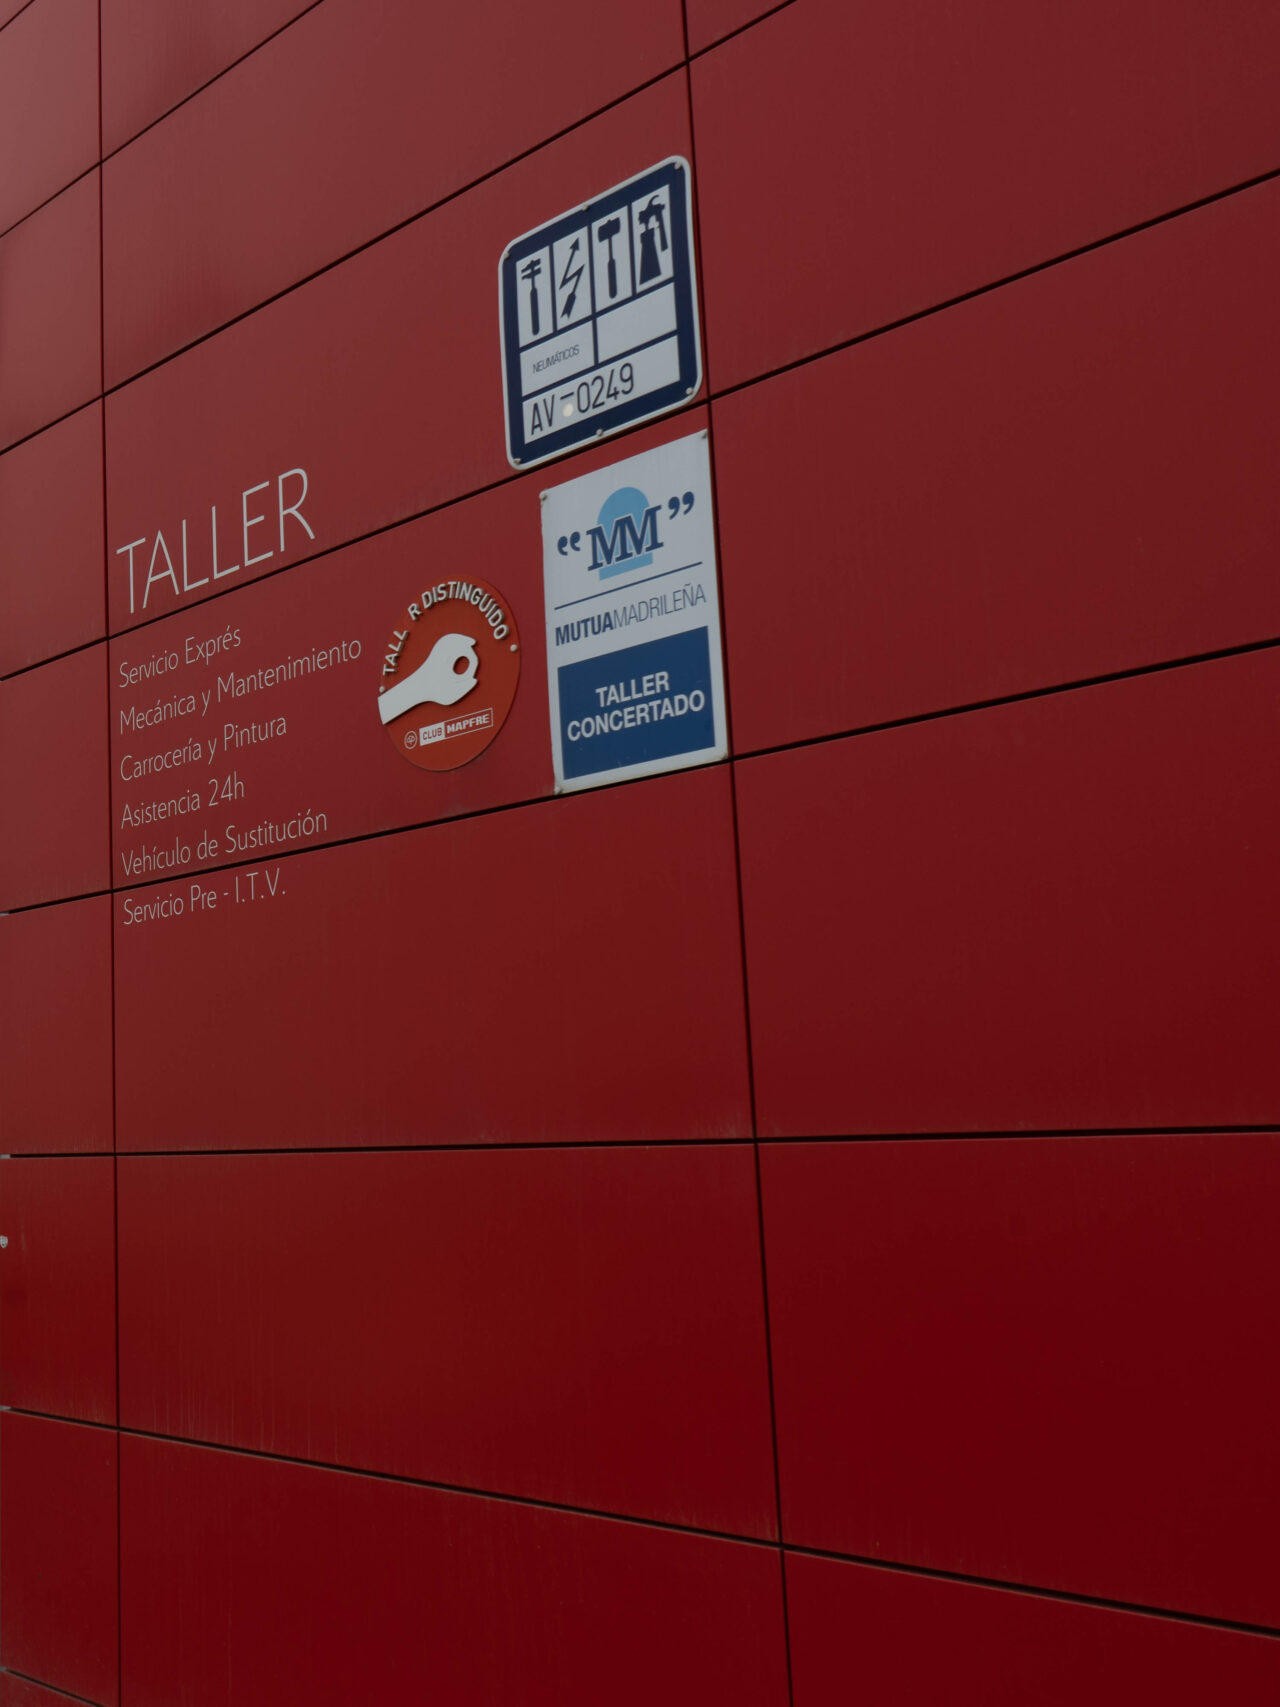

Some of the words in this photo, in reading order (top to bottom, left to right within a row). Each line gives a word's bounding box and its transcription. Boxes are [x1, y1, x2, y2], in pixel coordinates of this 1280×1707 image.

[532, 344, 580, 374] NEUMÁTICOS
[530, 362, 635, 436] AV-0249
[116, 467, 316, 614] TALLER
[421, 580, 510, 640] DISTINGUIDO
[119, 648, 179, 688] Servicio
[184, 624, 242, 667] Exprés
[120, 691, 196, 735] Mecánica
[201, 689, 211, 717] y
[217, 638, 362, 703] Mantenimiento
[567, 688, 706, 743] CONCERTADO
[595, 671, 670, 708] TALLER
[120, 737, 202, 782] Carrocería
[208, 738, 218, 766] y
[224, 716, 287, 752] Pintura
[422, 727, 443, 741] CLUB
[446, 713, 490, 734] MAPFRE
[121, 790, 201, 829] Asistencia
[208, 771, 245, 807] 24h
[121, 837, 191, 876] Vehículo
[197, 830, 219, 860] de
[225, 808, 328, 854] Sustitución
[123, 890, 184, 926] Servicio
[190, 883, 217, 912] Pre
[235, 868, 286, 904] I.T.V.
